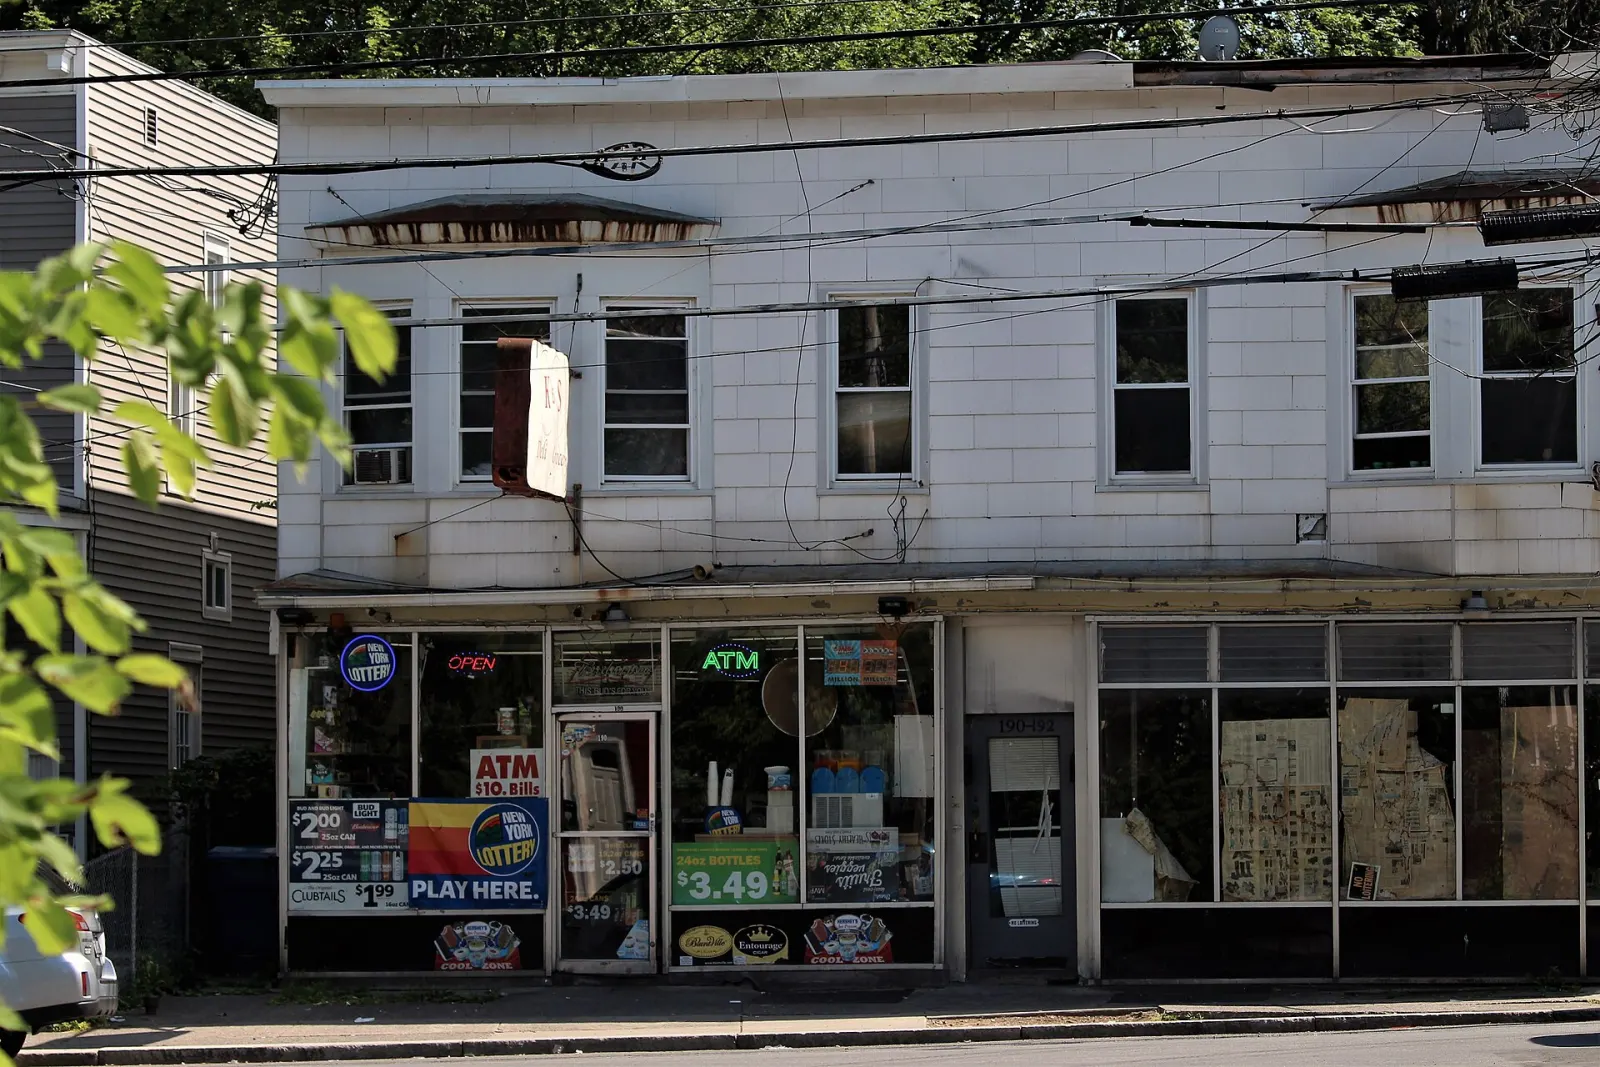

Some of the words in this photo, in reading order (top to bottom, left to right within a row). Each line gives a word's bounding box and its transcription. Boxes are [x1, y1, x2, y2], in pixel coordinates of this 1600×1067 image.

[367, 643, 385, 653] NEW
[368, 652, 390, 664] YORK
[448, 655, 496, 671] OPEN
[703, 651, 759, 670] ATM
[348, 664, 391, 682] LOTTERY
[999, 718, 1055, 733] 190-192
[475, 754, 539, 779] ATM
[475, 781, 507, 796] $10.
[509, 781, 540, 796] Bills
[502, 812, 526, 825] NEW
[721, 809, 735, 819] NEW
[723, 816, 740, 826] YORK
[321, 833, 338, 841] 25oz
[340, 833, 356, 841] CAN
[505, 825, 533, 841] YORK
[476, 838, 536, 867] LOTTERY
[600, 860, 642, 875] $2.50
[677, 855, 706, 866] 24oz
[709, 855, 761, 866] BOTTLES
[824, 860, 866, 875] veggies
[322, 873, 340, 881] 25oz
[341, 873, 357, 881] CAN
[835, 869, 882, 889] Fruits
[1352, 876, 1363, 888] NO
[1361, 866, 1375, 900] LOITERING
[412, 880, 468, 899] PLAY
[472, 881, 539, 899] HERE.
[677, 870, 768, 900] $3.49
[291, 889, 346, 903] CLUBTAILS
[567, 905, 611, 920] $3.49
[739, 941, 783, 952] Entourage
[441, 962, 473, 970] COOL
[481, 962, 513, 970] ZONE
[810, 956, 844, 964] COOL
